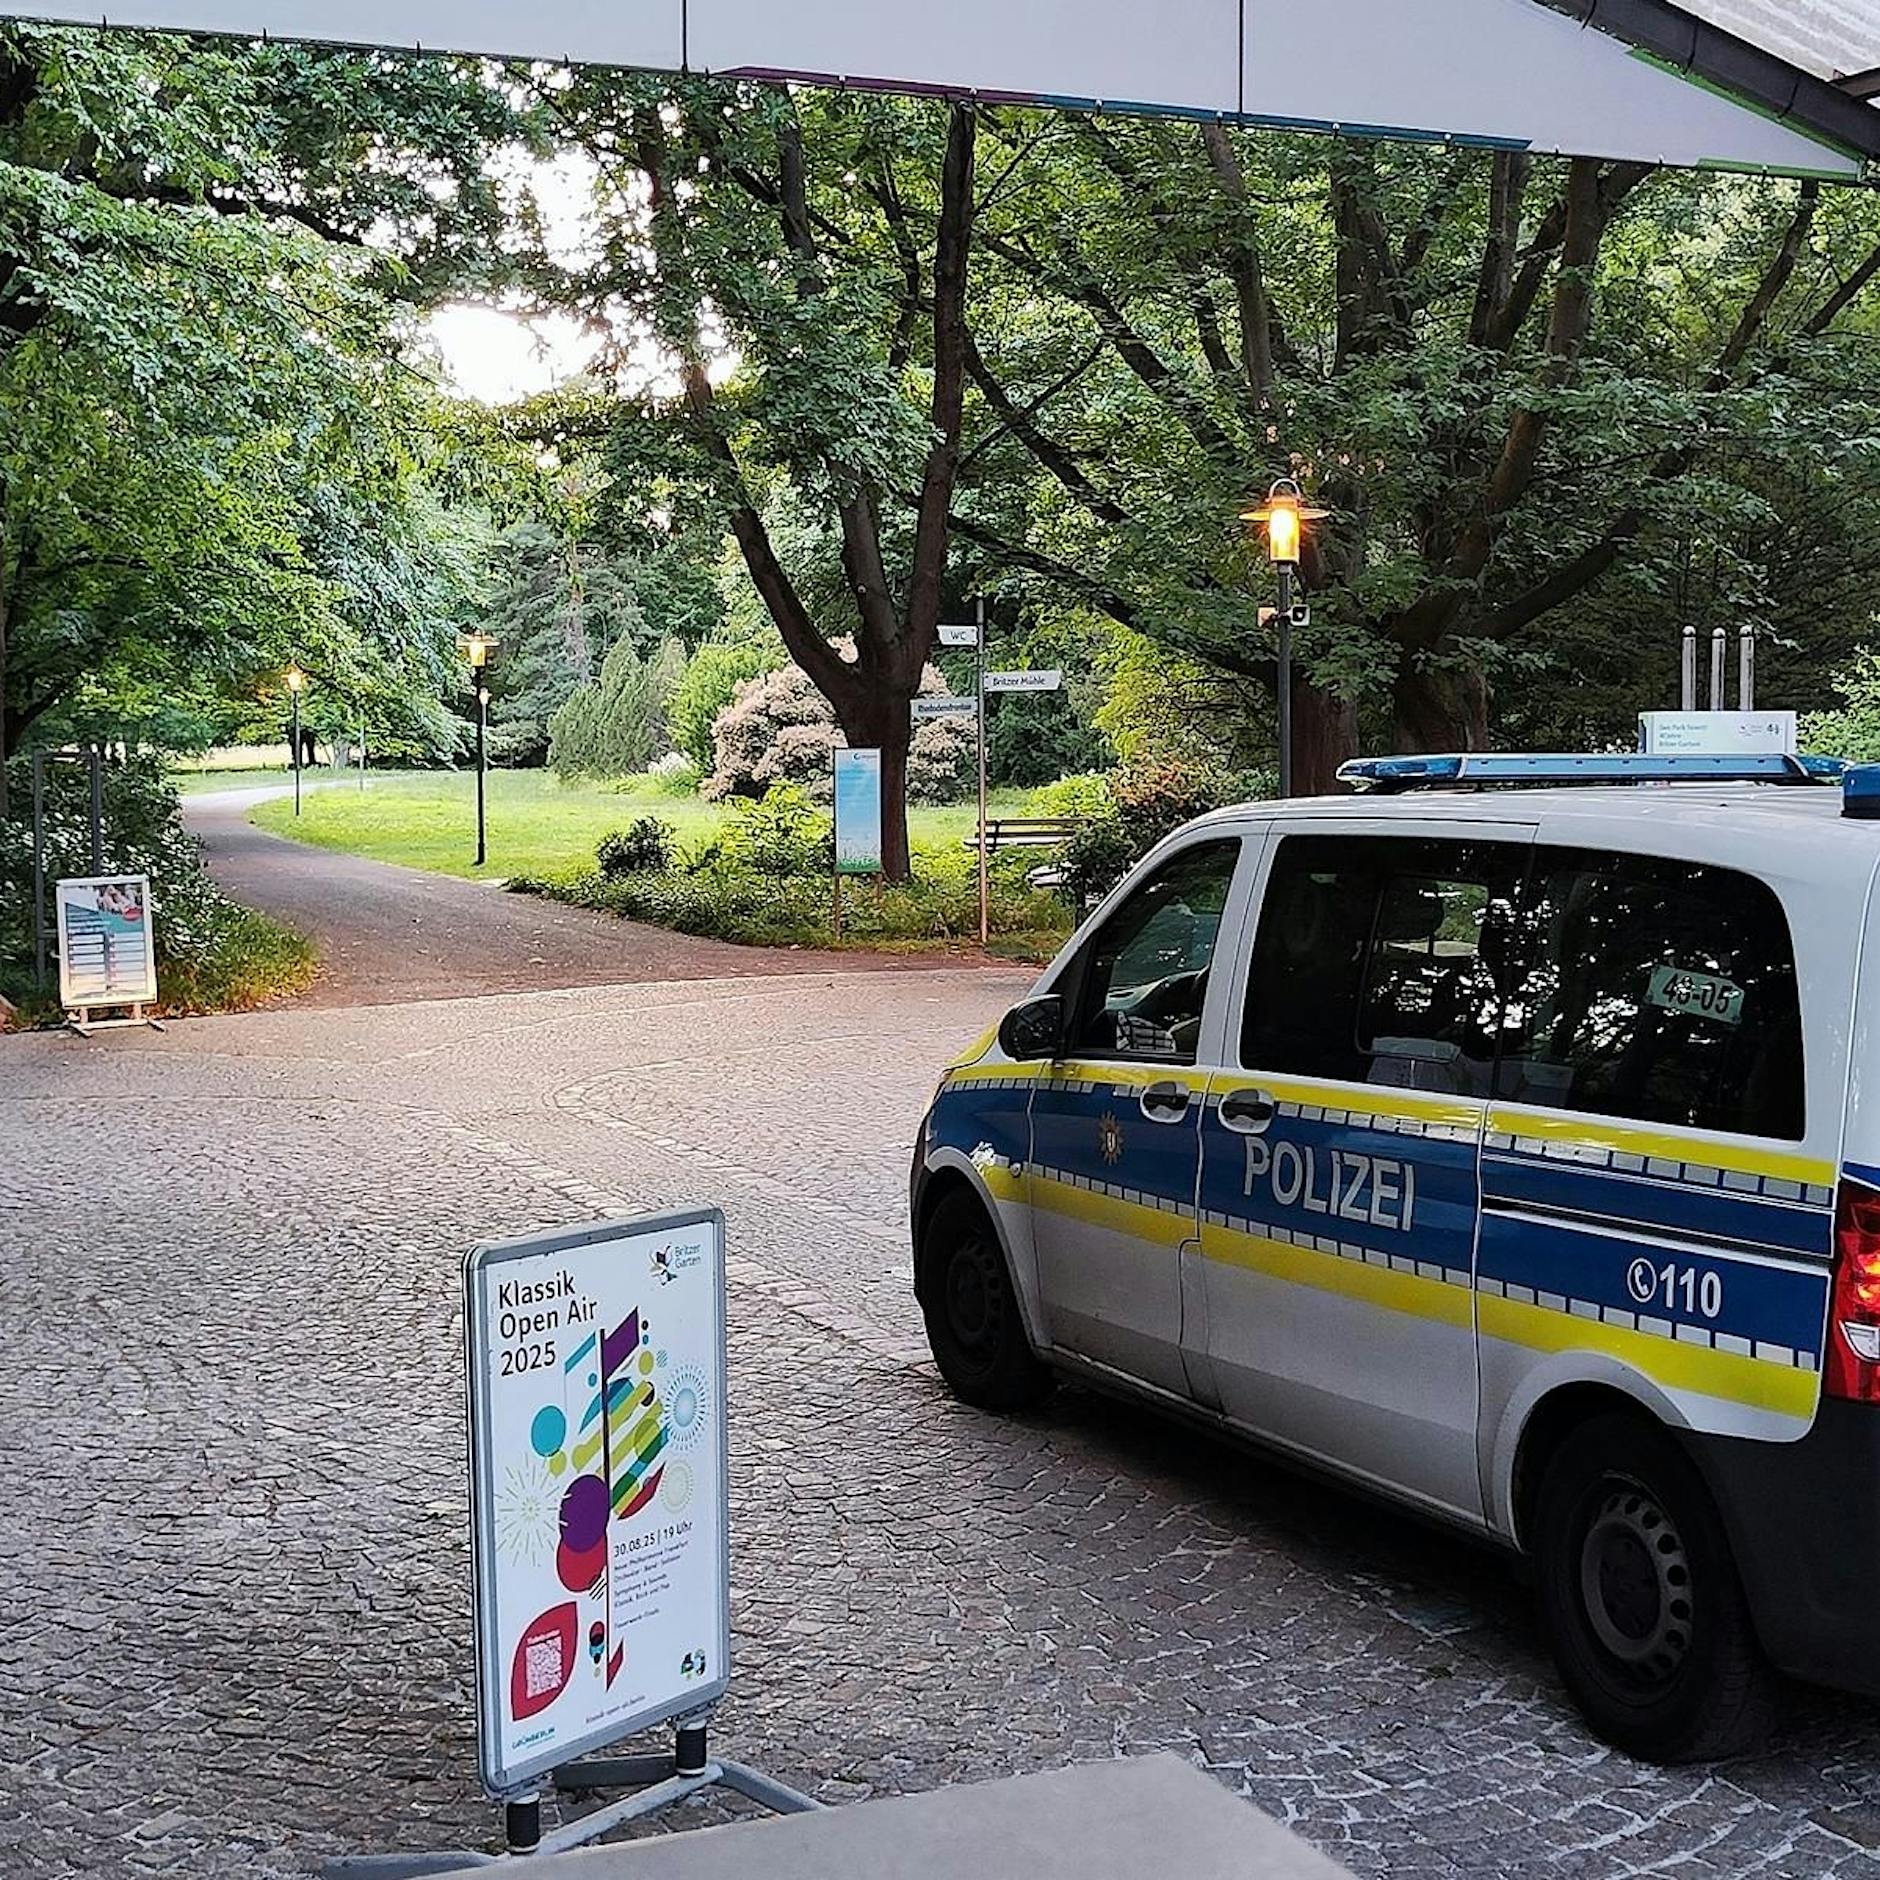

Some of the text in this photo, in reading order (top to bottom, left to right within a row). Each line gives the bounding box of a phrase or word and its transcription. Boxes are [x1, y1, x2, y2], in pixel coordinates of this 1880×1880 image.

[950, 631, 967, 641] WC
[993, 675, 1046, 686] Britzer Mühle
[1243, 1135, 1415, 1232] POLIZEI
[674, 1244, 701, 1257] Britzer
[674, 1255, 701, 1269] Garten
[499, 1270, 576, 1310] Klassik
[1660, 1263, 1722, 1318] 110
[500, 1296, 598, 1343] Open Air
[500, 1341, 556, 1377] 2025
[663, 1526, 675, 1539] 19
